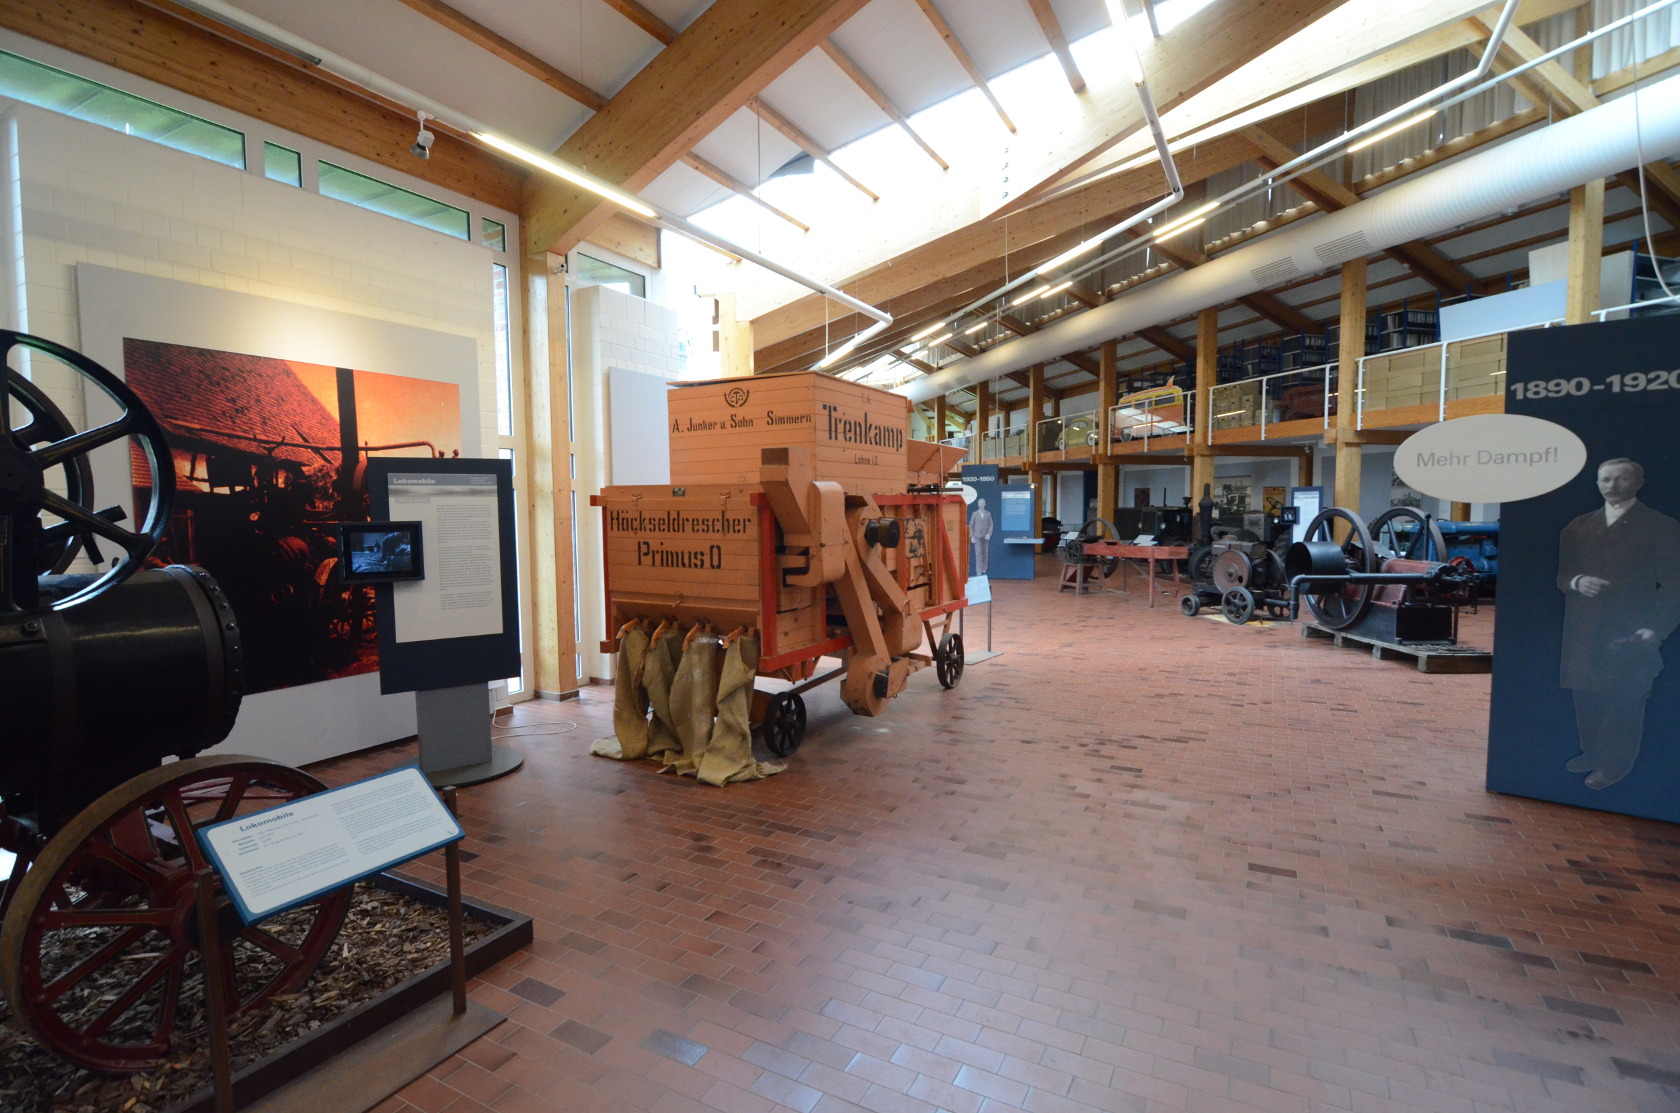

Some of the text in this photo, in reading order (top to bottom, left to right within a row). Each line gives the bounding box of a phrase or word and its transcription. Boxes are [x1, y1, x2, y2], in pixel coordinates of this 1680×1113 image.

[672, 418, 684, 433] A.
[687, 417, 718, 433] Junker
[730, 413, 754, 429] Sohn
[766, 410, 812, 426] Simmern
[822, 403, 903, 452] Trenkamp
[1416, 446, 1558, 467] Mehr Dampf!
[610, 510, 752, 534] Häckseldrescher
[637, 541, 705, 569] Primus
[239, 811, 294, 832] Lokomobile
